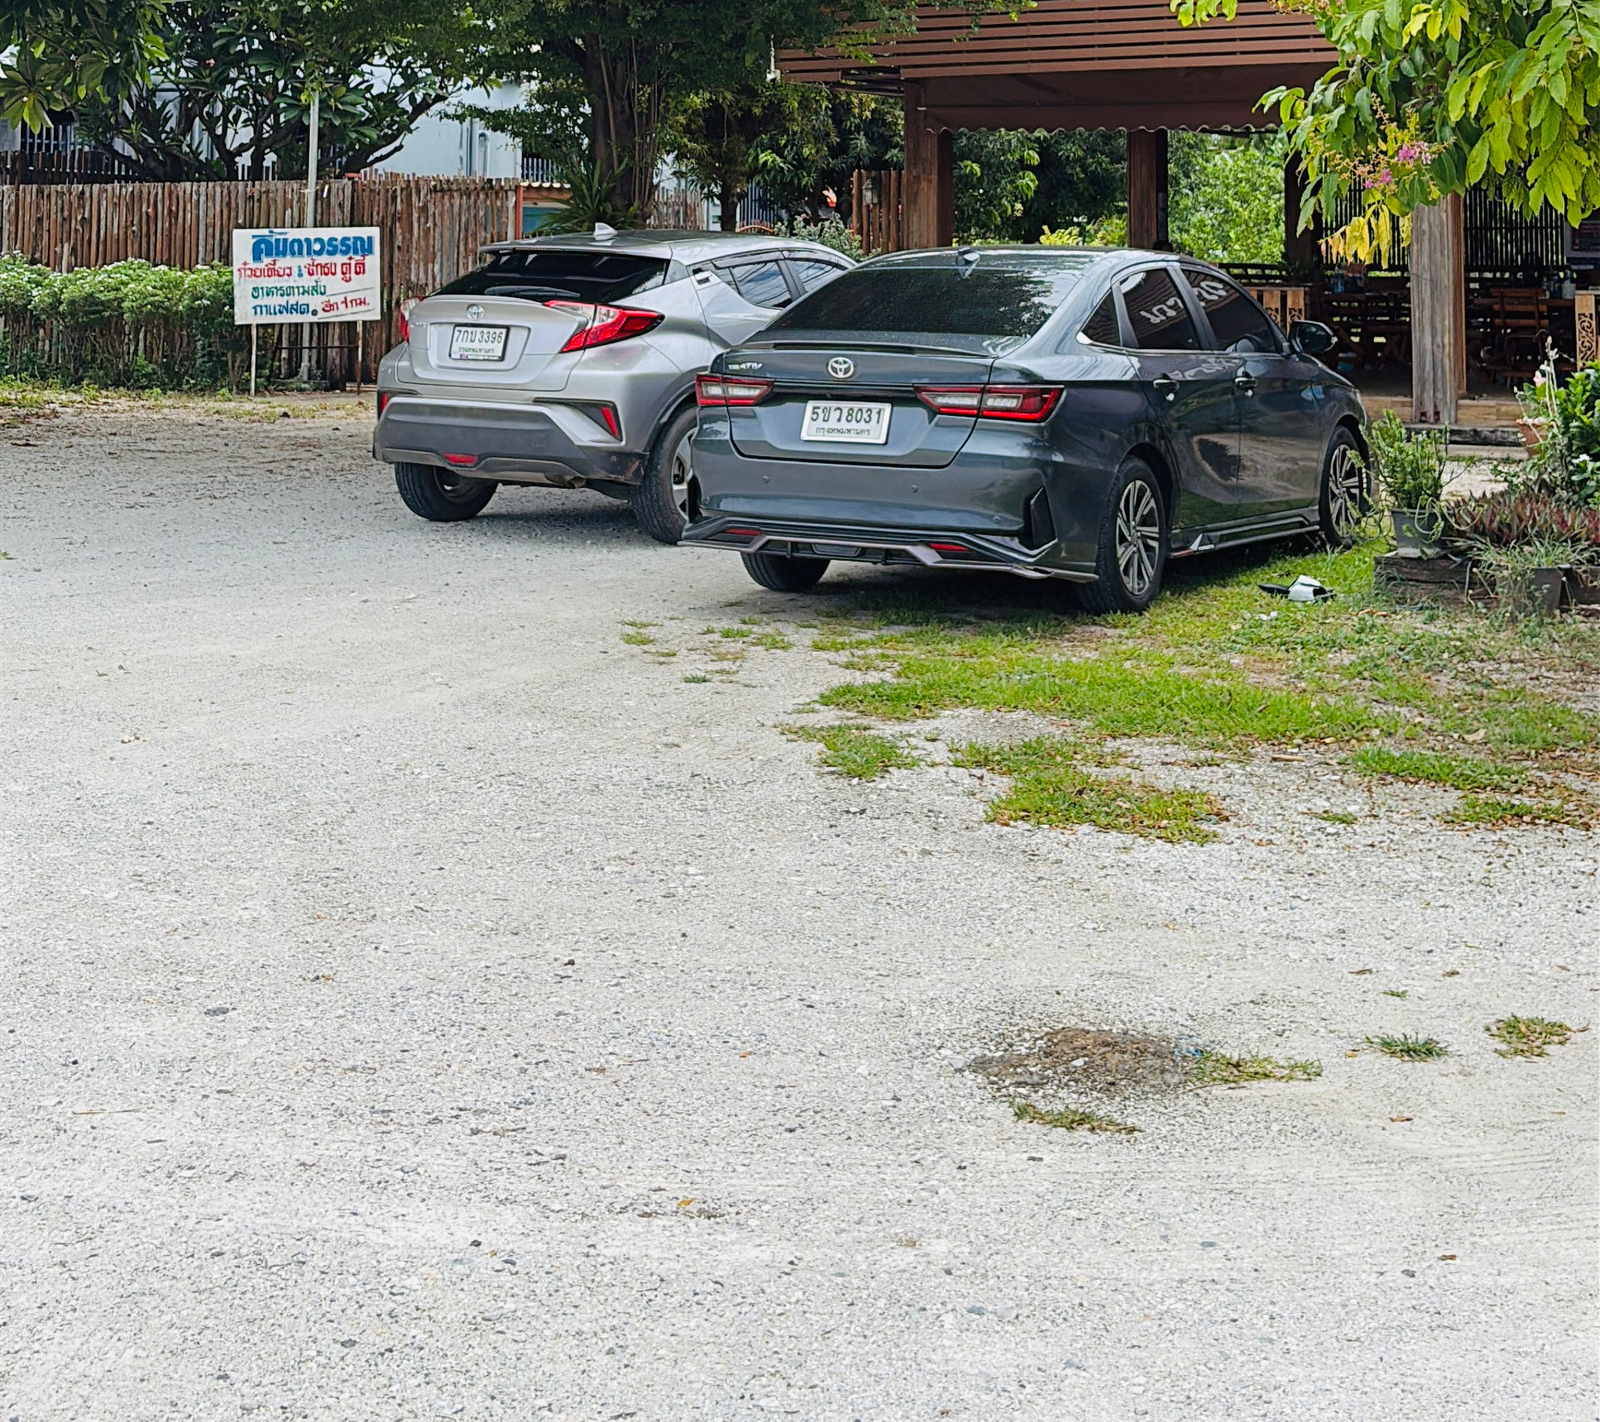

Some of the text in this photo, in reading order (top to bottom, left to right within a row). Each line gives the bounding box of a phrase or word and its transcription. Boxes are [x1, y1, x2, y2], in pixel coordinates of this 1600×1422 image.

[251, 278, 327, 299] อาหารตามสั่ง
[252, 301, 310, 316] กาแฟสด
[478, 330, 504, 344] 3396
[811, 406, 882, 425] 5ขว 8031
